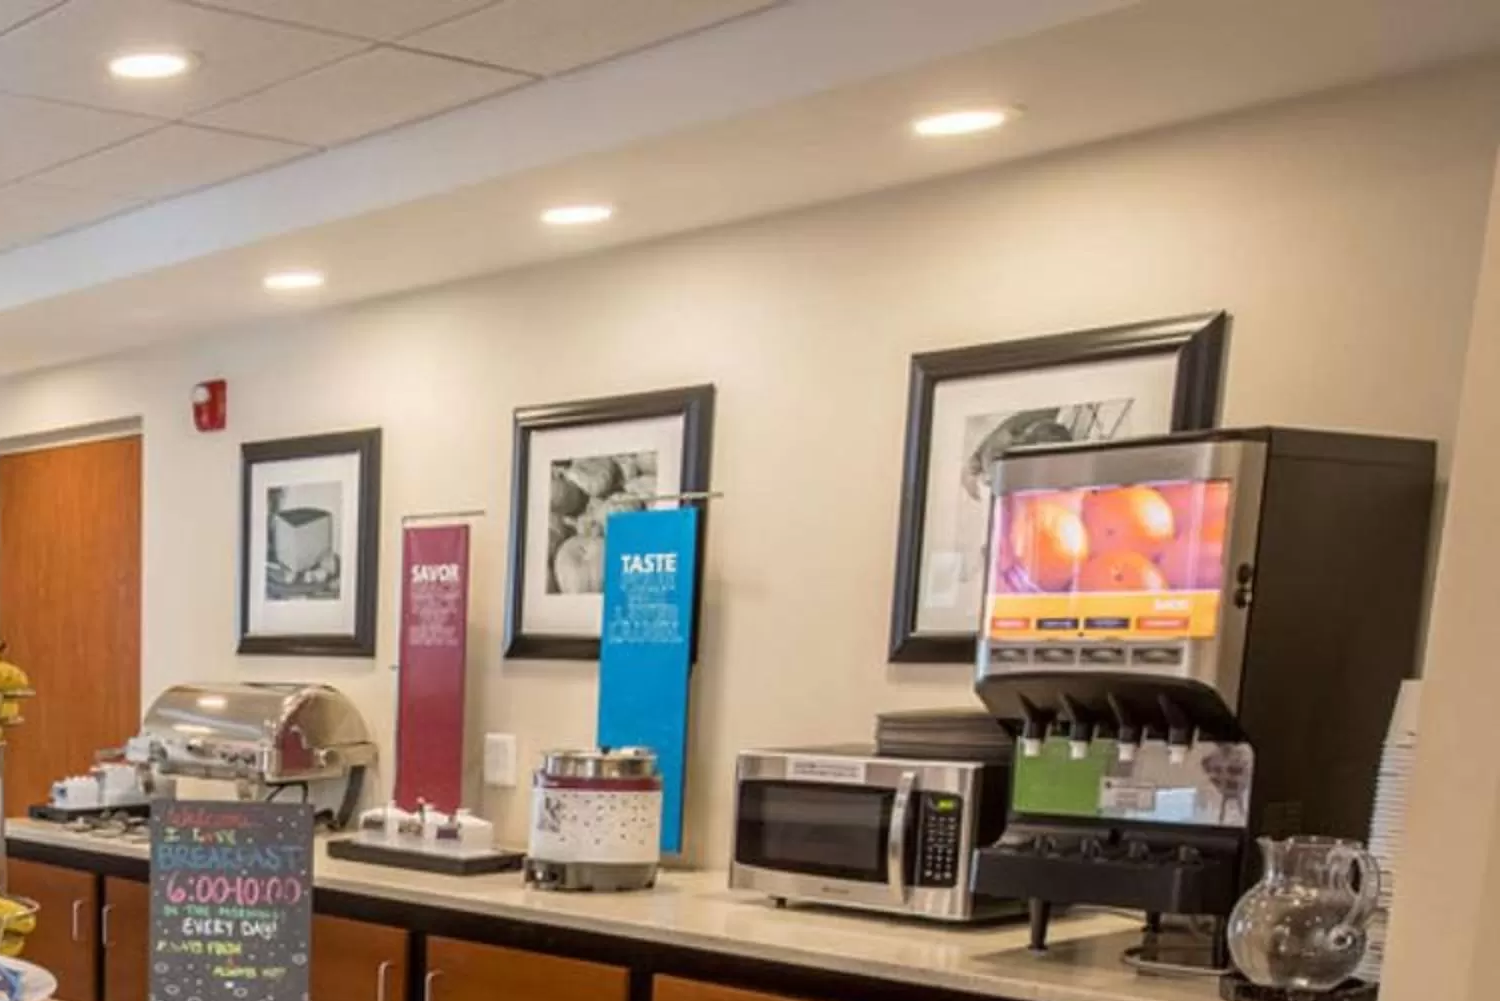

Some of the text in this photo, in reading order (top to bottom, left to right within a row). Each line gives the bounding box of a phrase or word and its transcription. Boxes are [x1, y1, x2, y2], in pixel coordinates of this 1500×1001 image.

[411, 564, 459, 582] SAVOR
[621, 553, 677, 573] TASTE
[182, 917, 234, 937] EVERY
